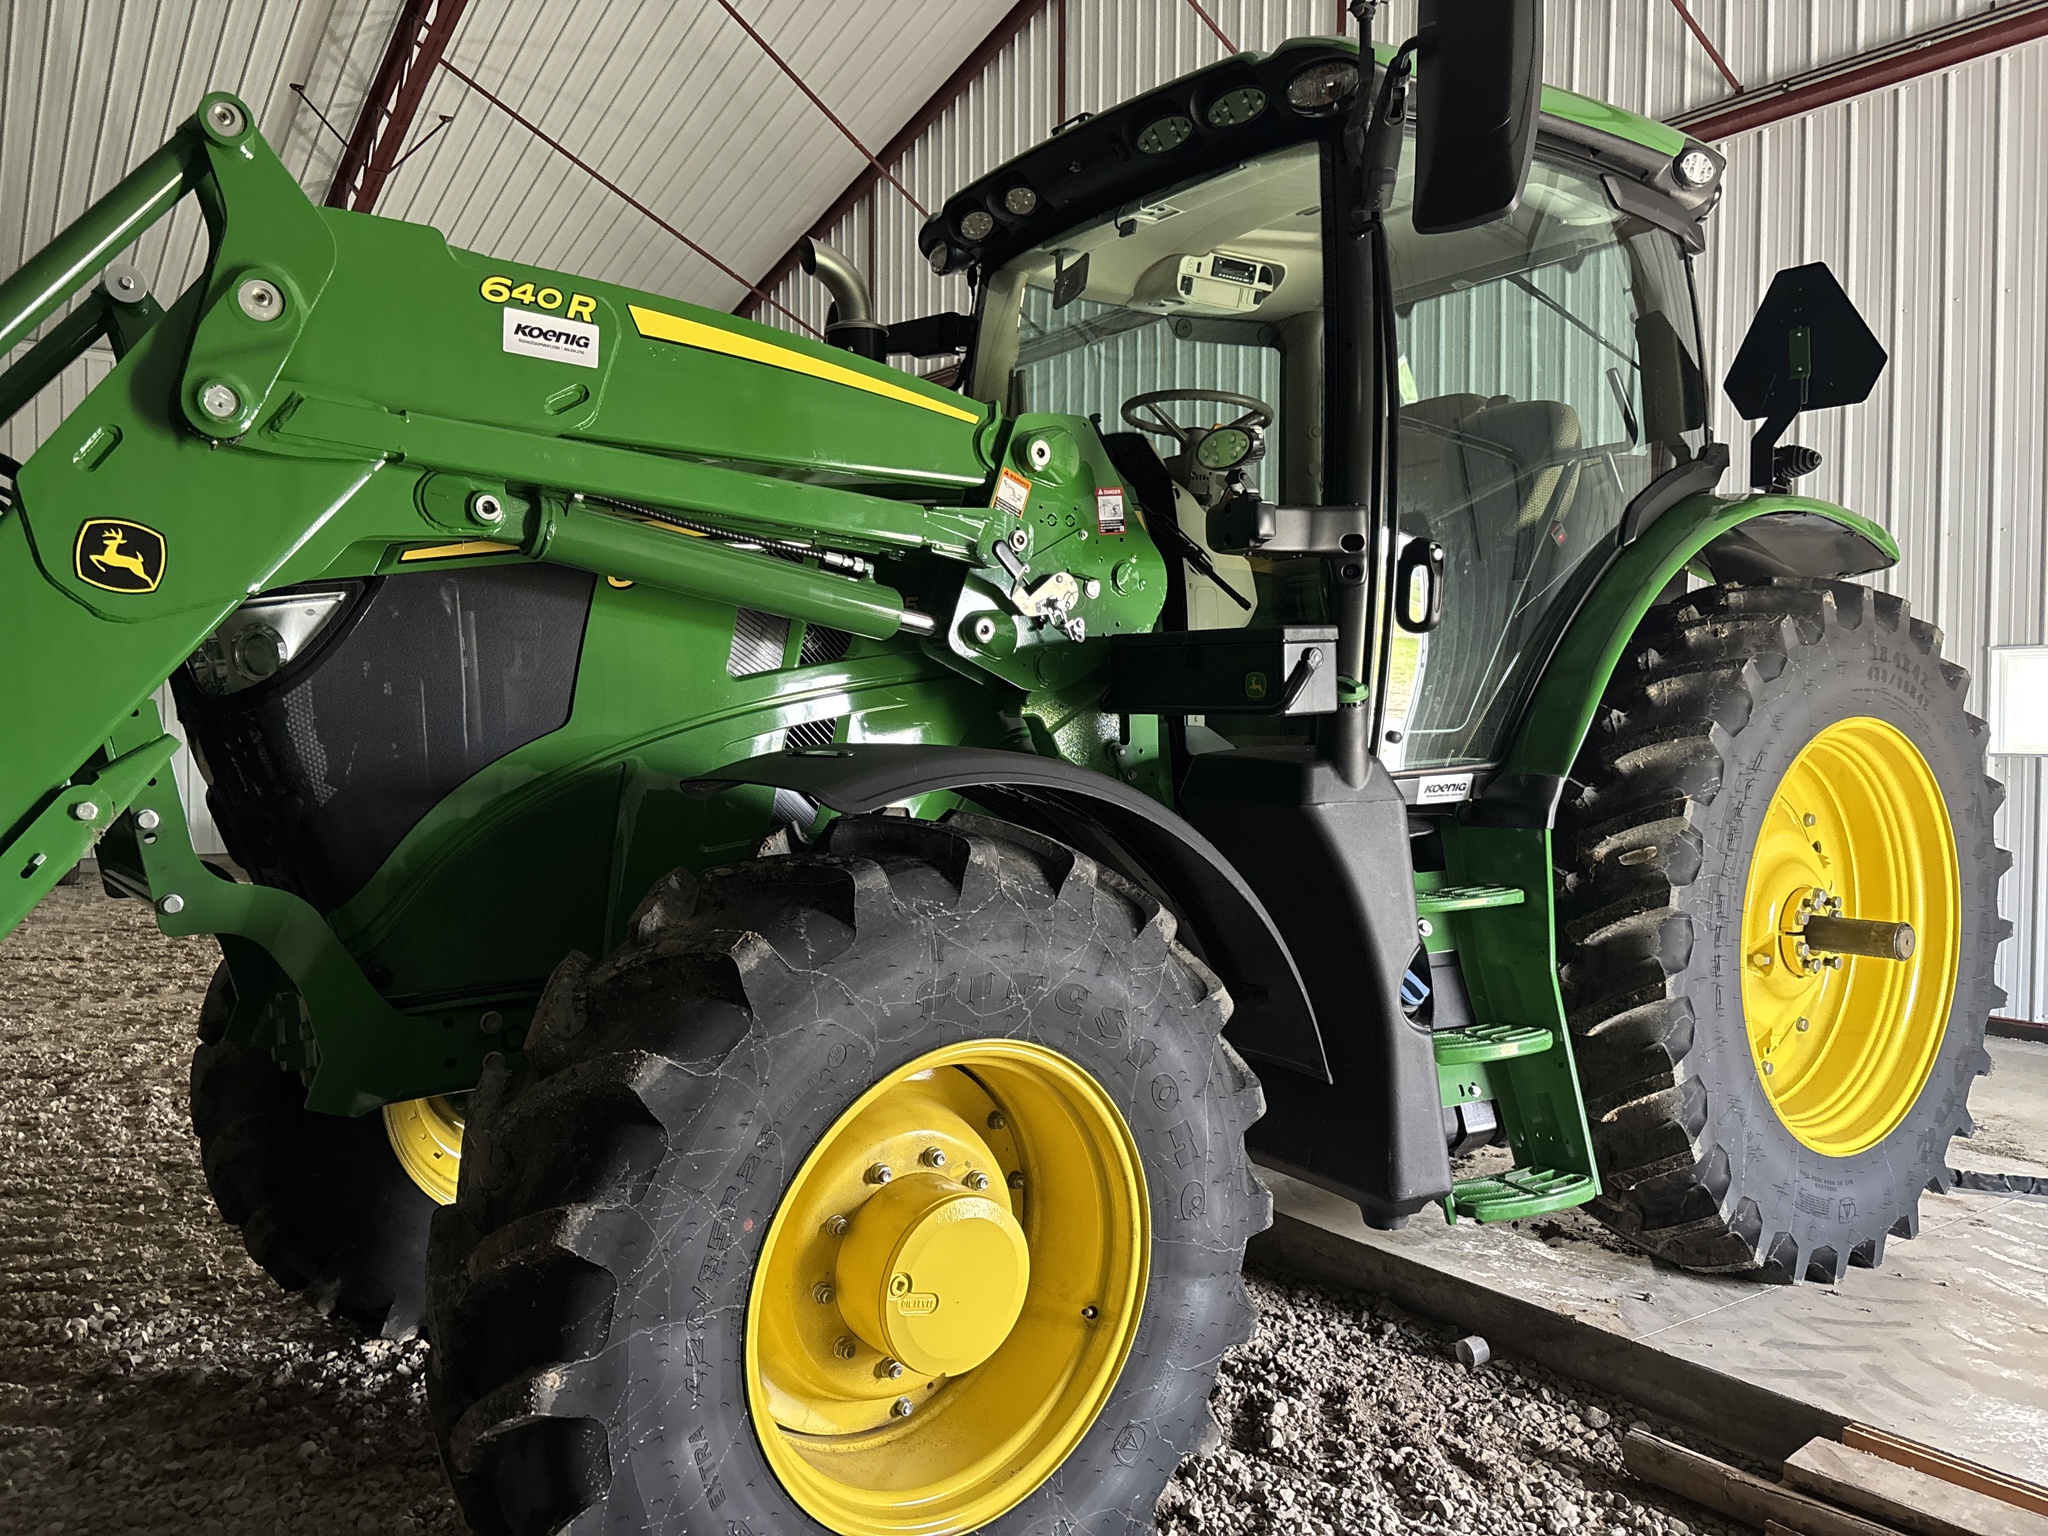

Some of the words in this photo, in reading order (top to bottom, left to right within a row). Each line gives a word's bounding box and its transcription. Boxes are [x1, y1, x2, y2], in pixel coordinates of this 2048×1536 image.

[479, 274, 565, 311] 640
[565, 290, 599, 325] R
[1009, 474, 1030, 489] WARNING
[687, 1425, 728, 1512] EXTRA
